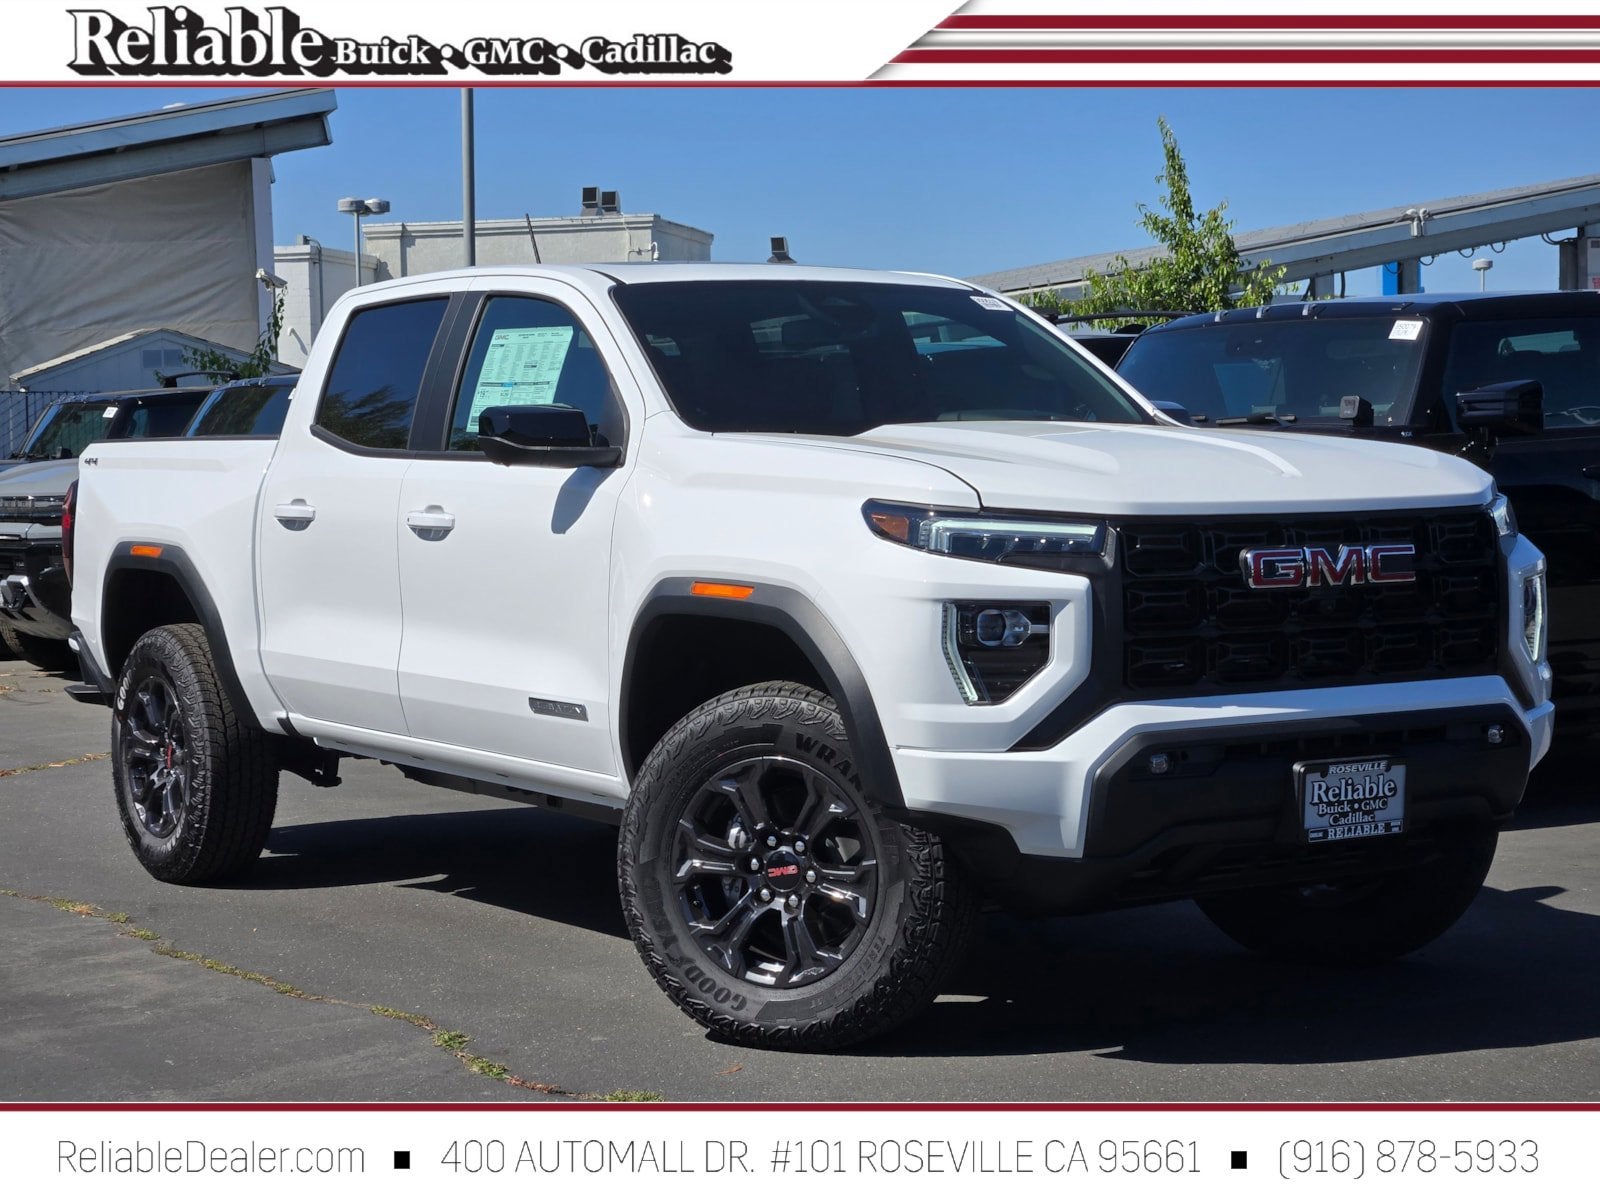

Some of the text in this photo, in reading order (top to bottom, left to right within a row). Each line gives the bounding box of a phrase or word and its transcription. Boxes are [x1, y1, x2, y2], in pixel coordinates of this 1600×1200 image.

[1239, 544, 1416, 588] GMC
[1328, 761, 1387, 774] ROSEVILLE
[1311, 775, 1396, 804] Reliable
[1318, 798, 1388, 815] Buick GMC
[1329, 812, 1375, 826] Cadillac
[1327, 823, 1386, 839] RELIABLE
[767, 864, 799, 878] GMC
